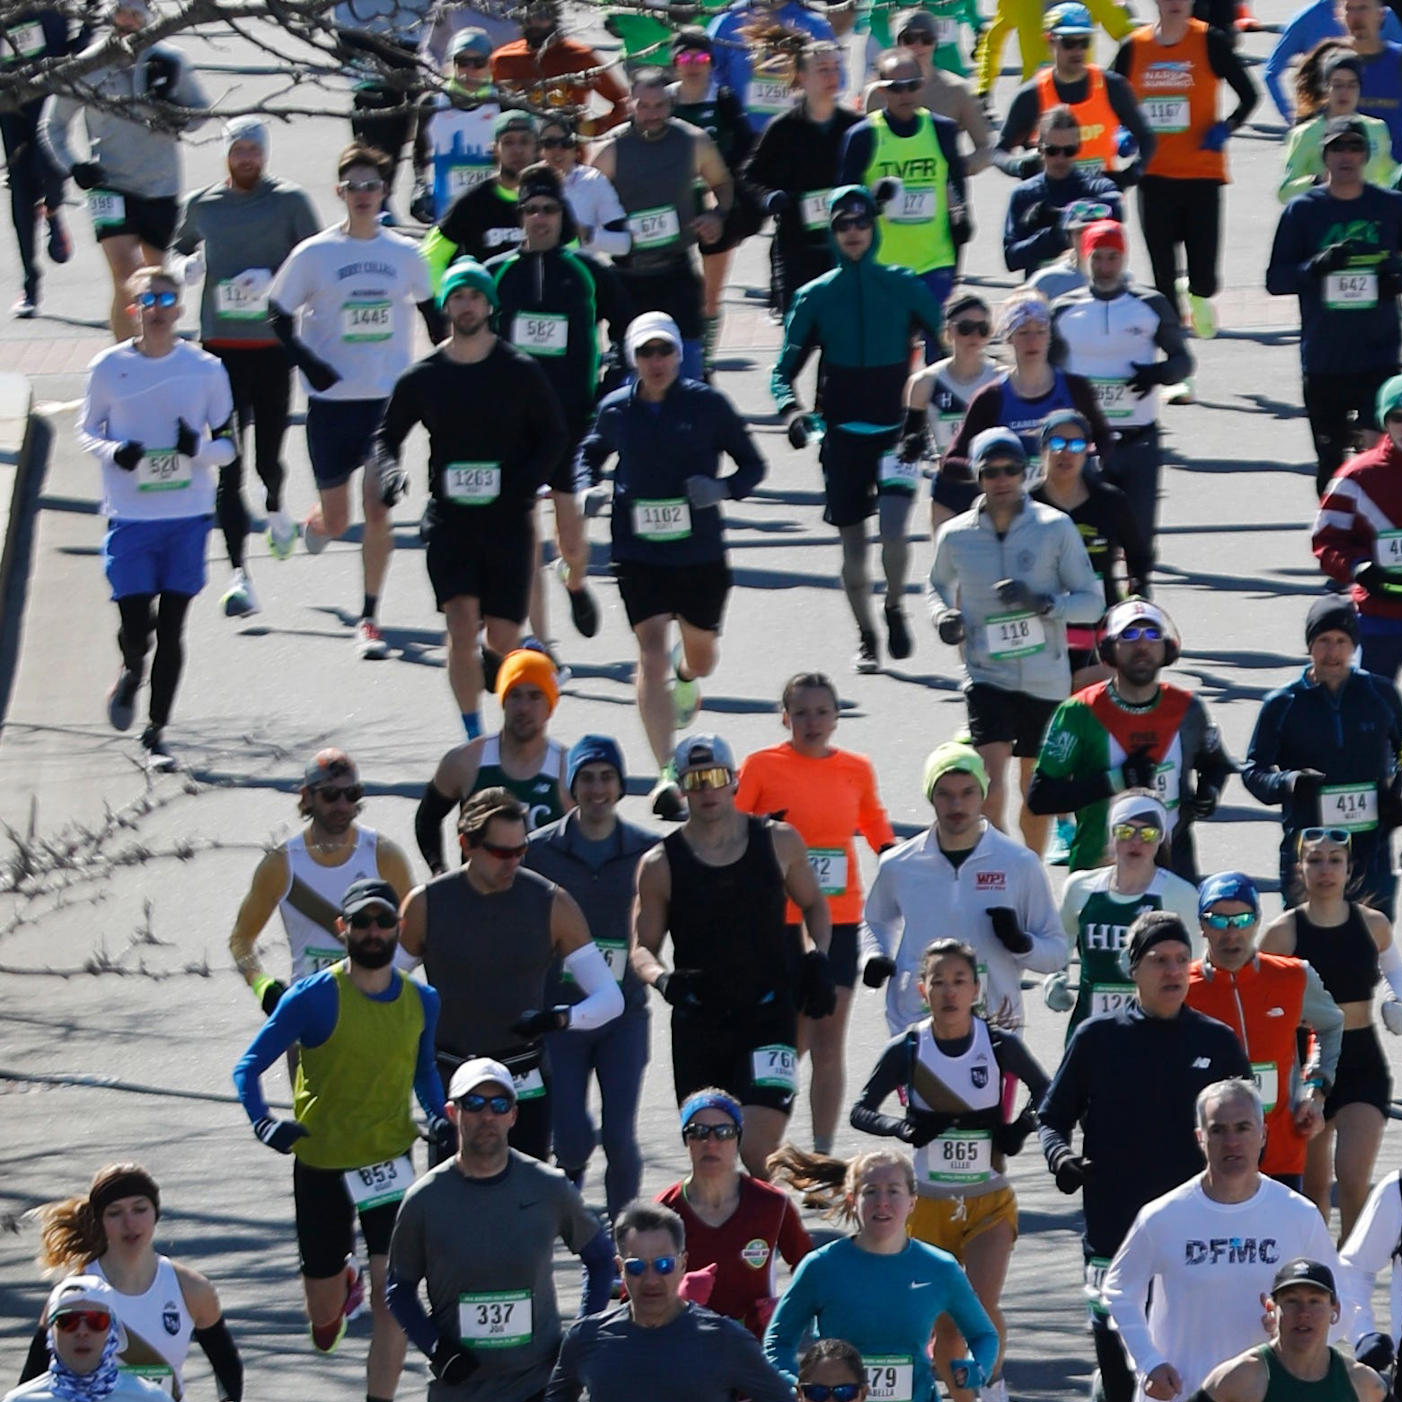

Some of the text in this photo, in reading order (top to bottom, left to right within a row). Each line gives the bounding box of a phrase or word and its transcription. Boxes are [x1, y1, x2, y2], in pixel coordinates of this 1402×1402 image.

[1001, 621, 1029, 641] 118
[1336, 794, 1367, 813] 414
[976, 873, 1007, 886] WPI
[943, 1141, 979, 1161] 865
[359, 1160, 400, 1188] 853
[1184, 1239, 1279, 1266] DFMC
[476, 1302, 516, 1325] 337
[863, 1367, 897, 1389] 79
